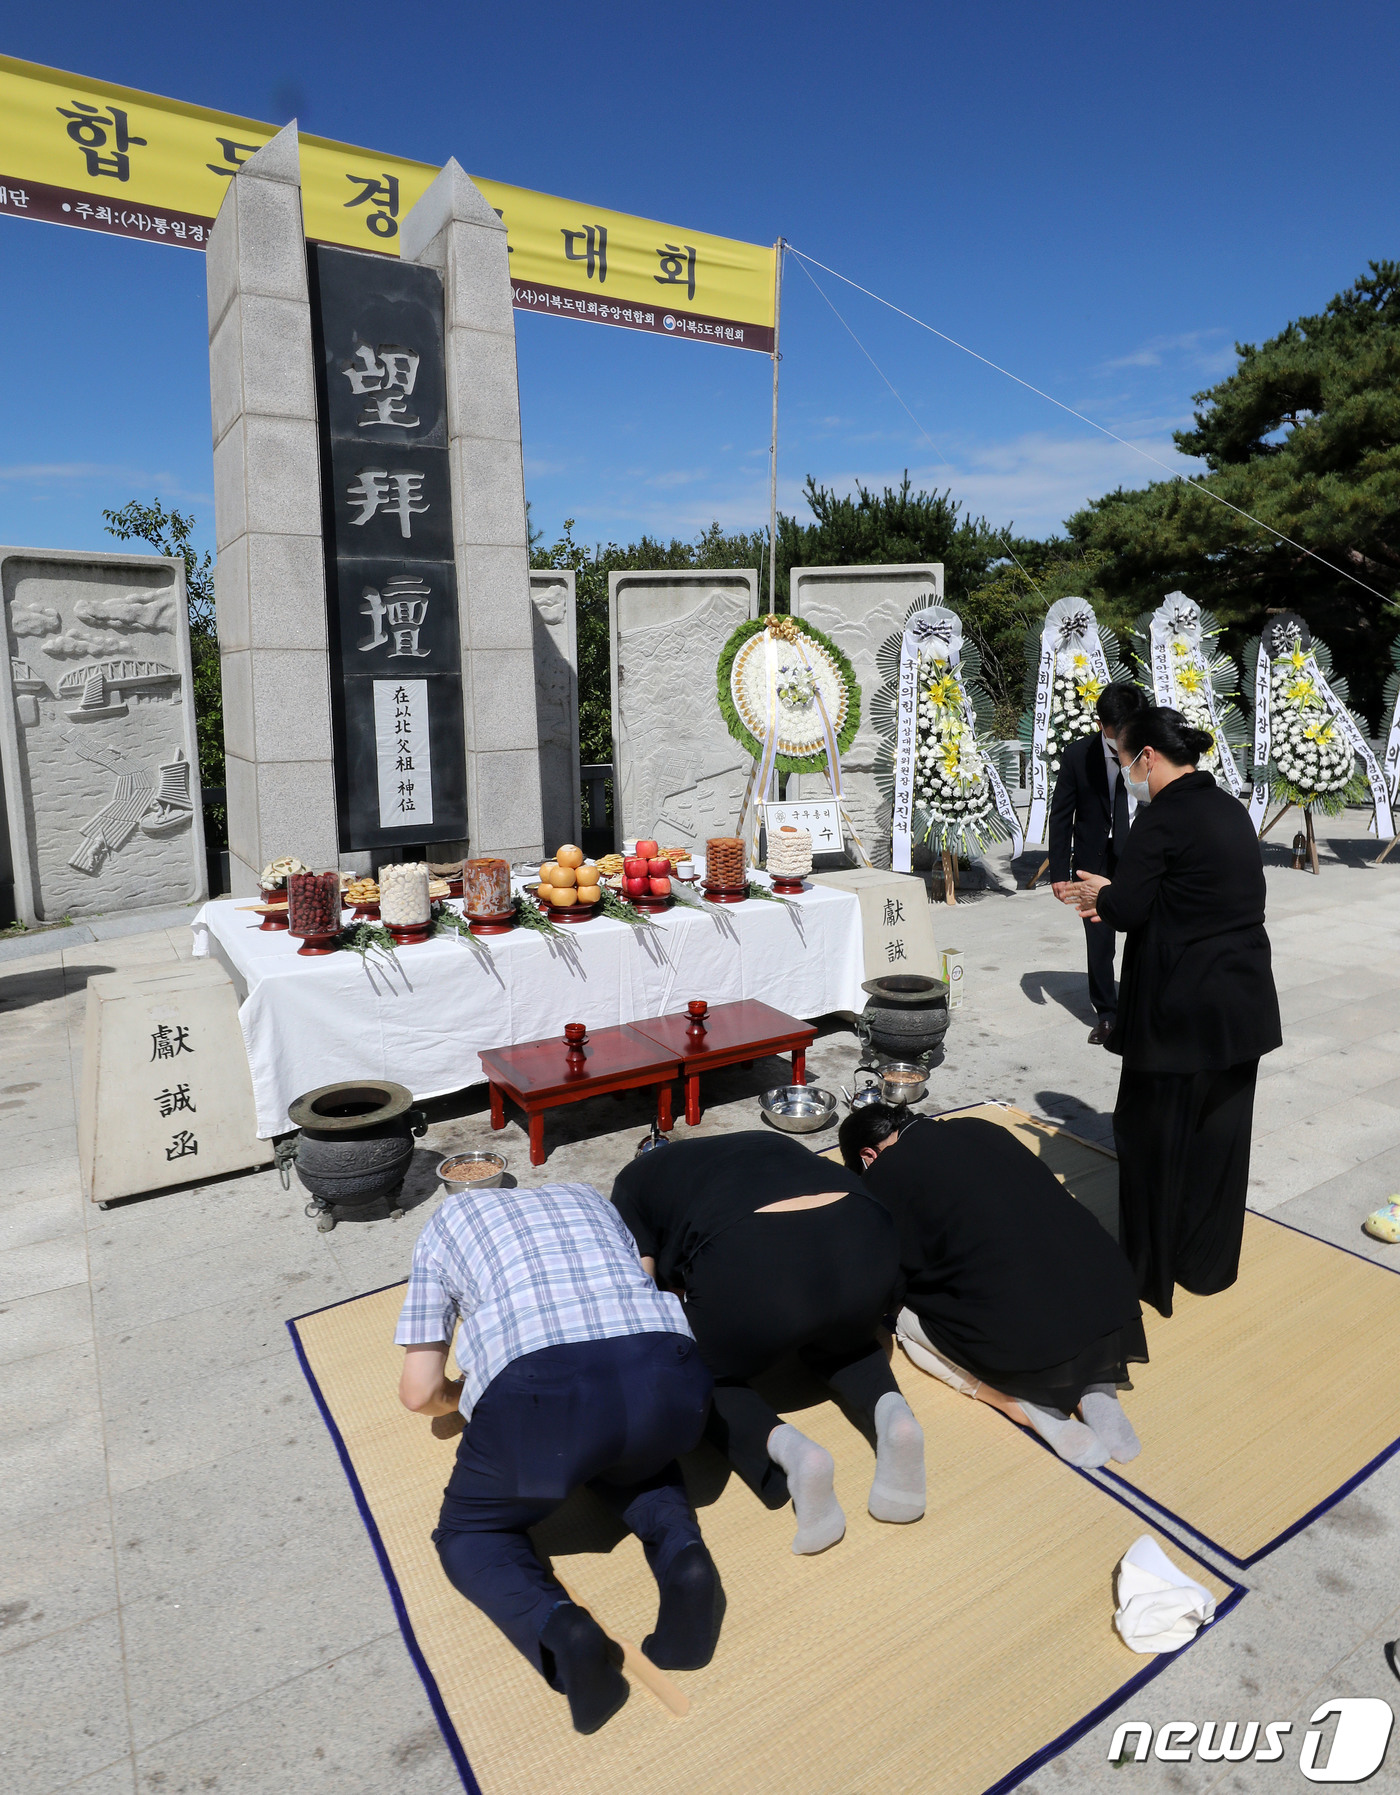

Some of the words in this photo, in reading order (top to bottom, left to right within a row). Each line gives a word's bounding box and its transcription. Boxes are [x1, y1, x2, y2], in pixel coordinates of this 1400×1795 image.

[74, 201, 212, 243] 주최:(사)통일경
[676, 318, 744, 342] 이북5도위원회
[900, 658, 917, 714] 국민의힘
[1035, 651, 1054, 732] 국회의원
[1257, 656, 1269, 734] 파주시장
[899, 716, 914, 787] 비상대책위원장
[1255, 740, 1268, 805] 김일
[894, 789, 910, 834] 정진석
